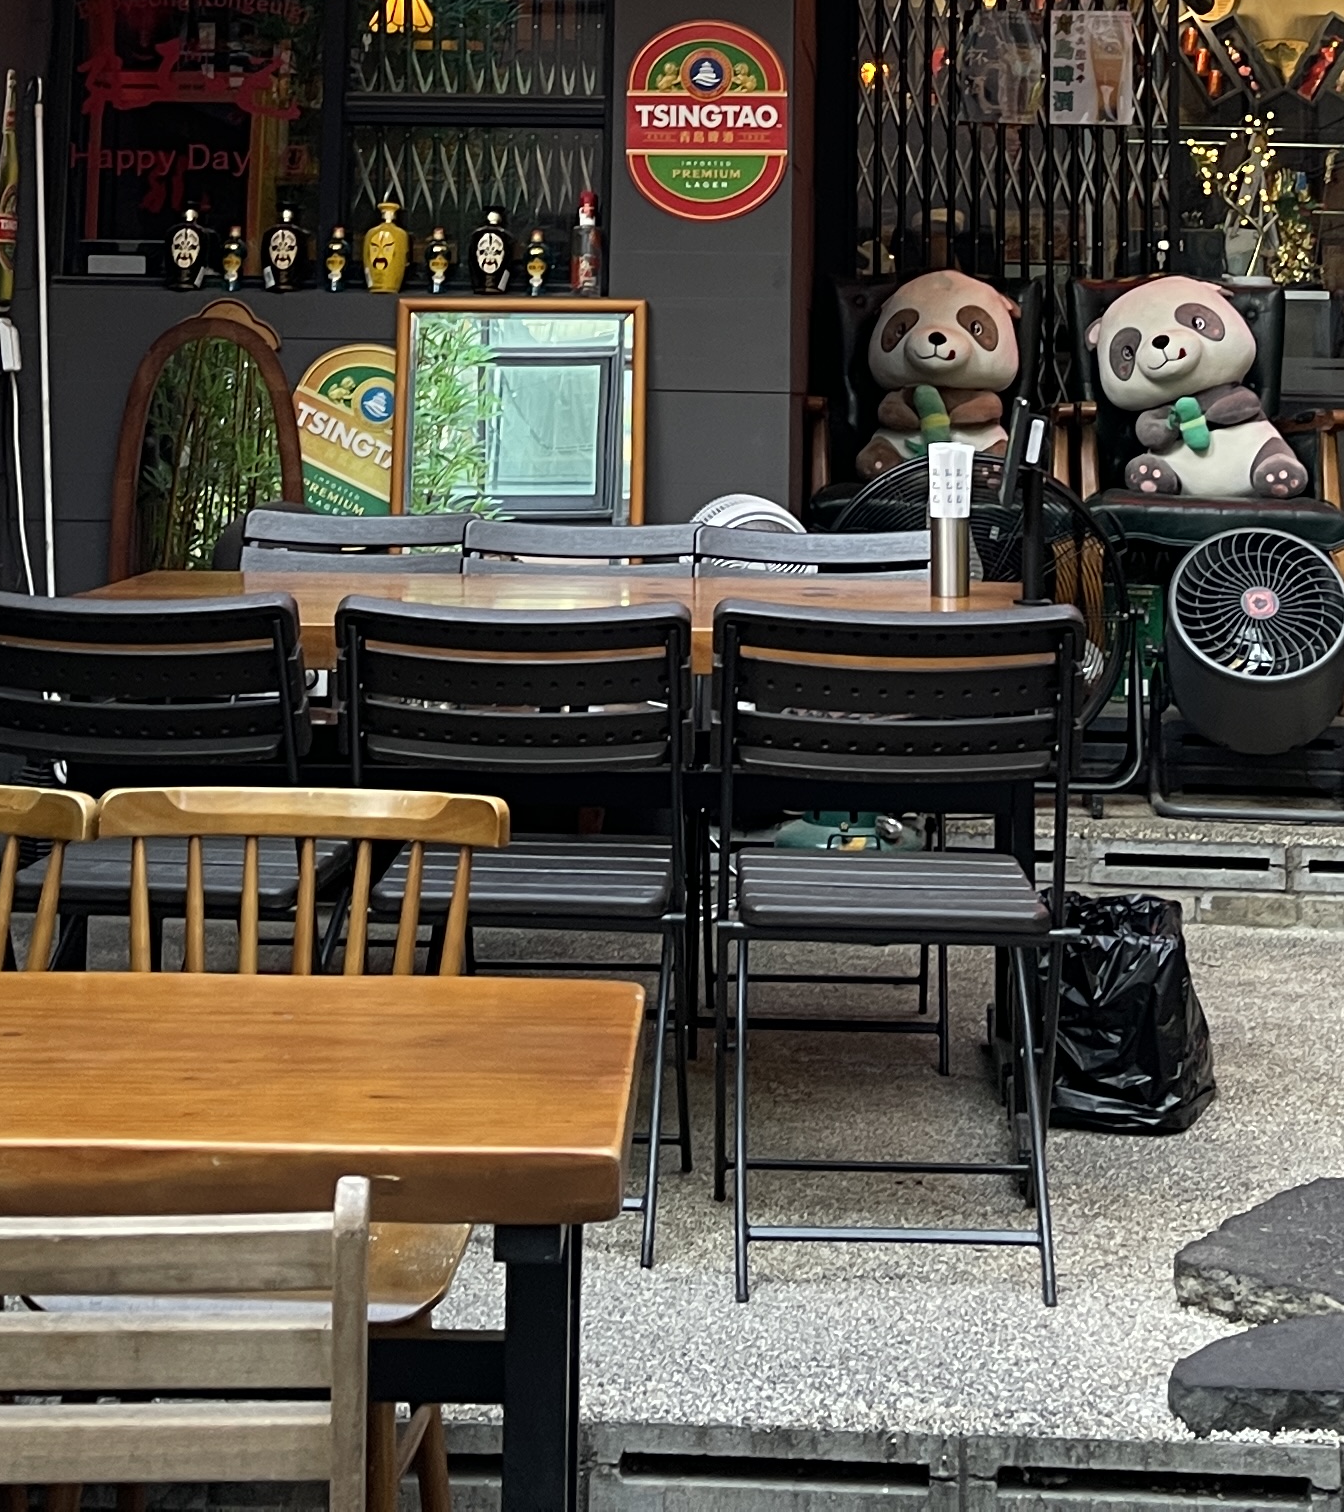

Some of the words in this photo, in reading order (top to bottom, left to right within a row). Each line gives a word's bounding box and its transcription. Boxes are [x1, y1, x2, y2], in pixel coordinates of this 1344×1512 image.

[635, 104, 779, 129] TSINGTAO
[69, 143, 177, 177] Happy
[187, 143, 252, 175] Day
[671, 168, 742, 180] PREMIUM
